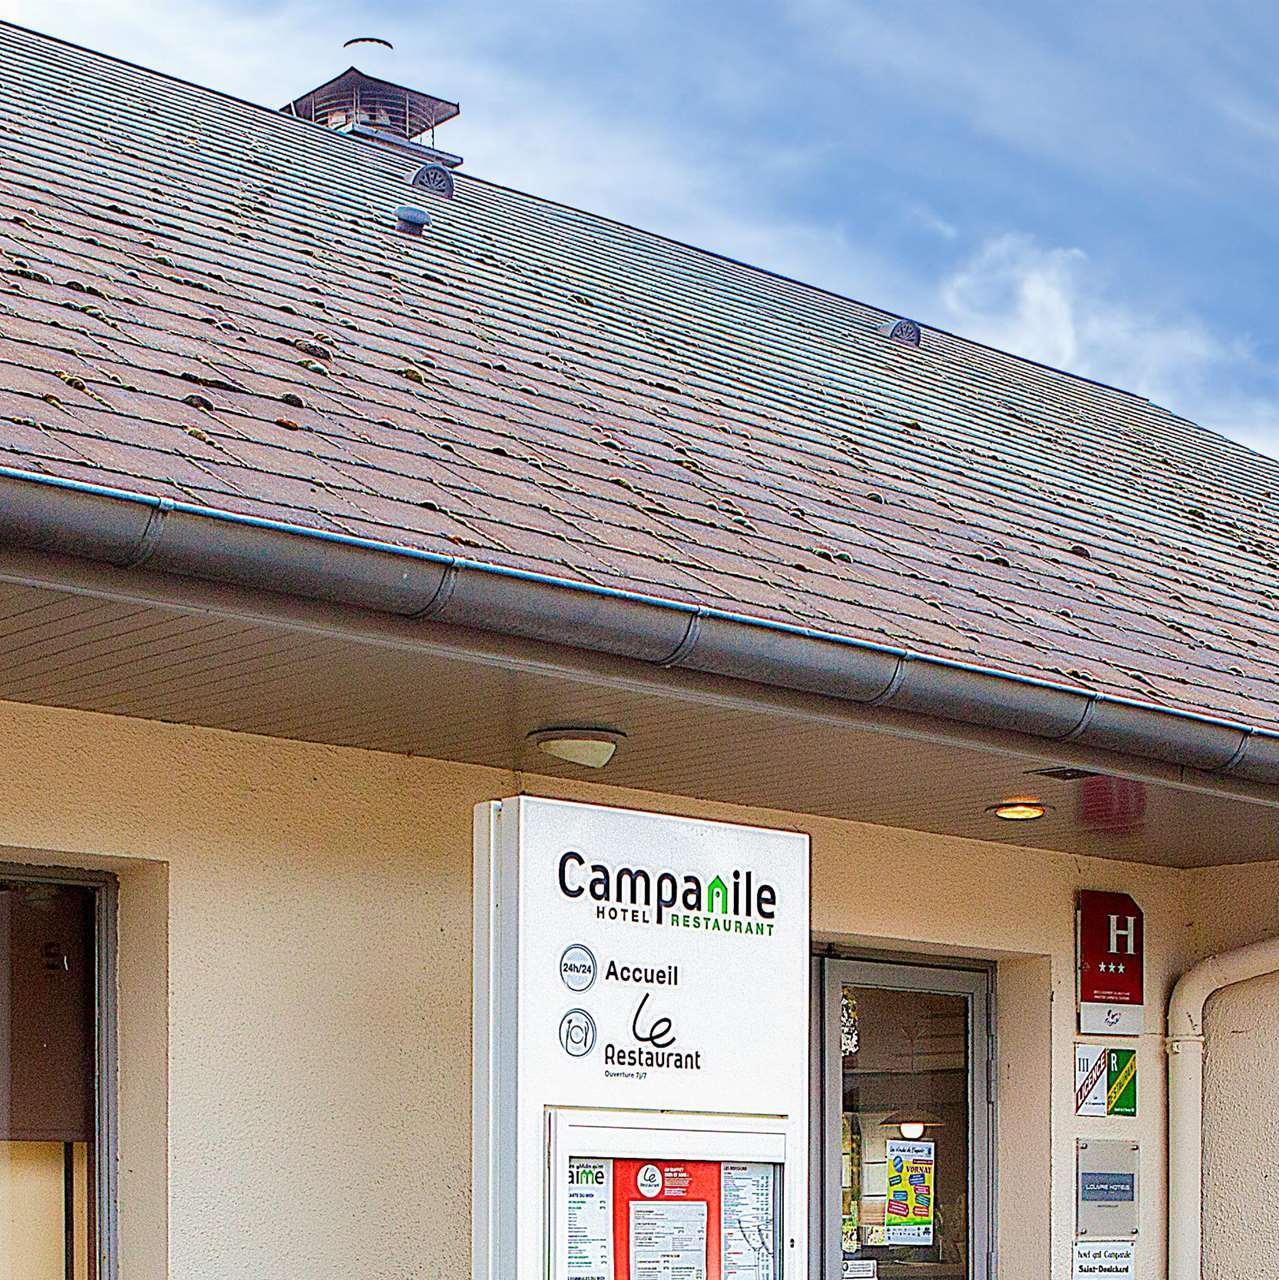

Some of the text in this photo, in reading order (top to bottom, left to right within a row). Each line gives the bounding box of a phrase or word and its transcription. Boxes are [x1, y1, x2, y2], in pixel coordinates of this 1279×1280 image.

[558, 851, 777, 925] Campanile
[596, 906, 774, 936] HOTEL RESTAURANT
[1106, 914, 1136, 955] H
[563, 963, 592, 974] 24h/24
[605, 960, 678, 985] Accueil
[632, 992, 676, 1048] Le
[605, 1043, 701, 1070] Restaurant
[1110, 1053, 1118, 1071] R
[1077, 1052, 1107, 1108] LICENCE
